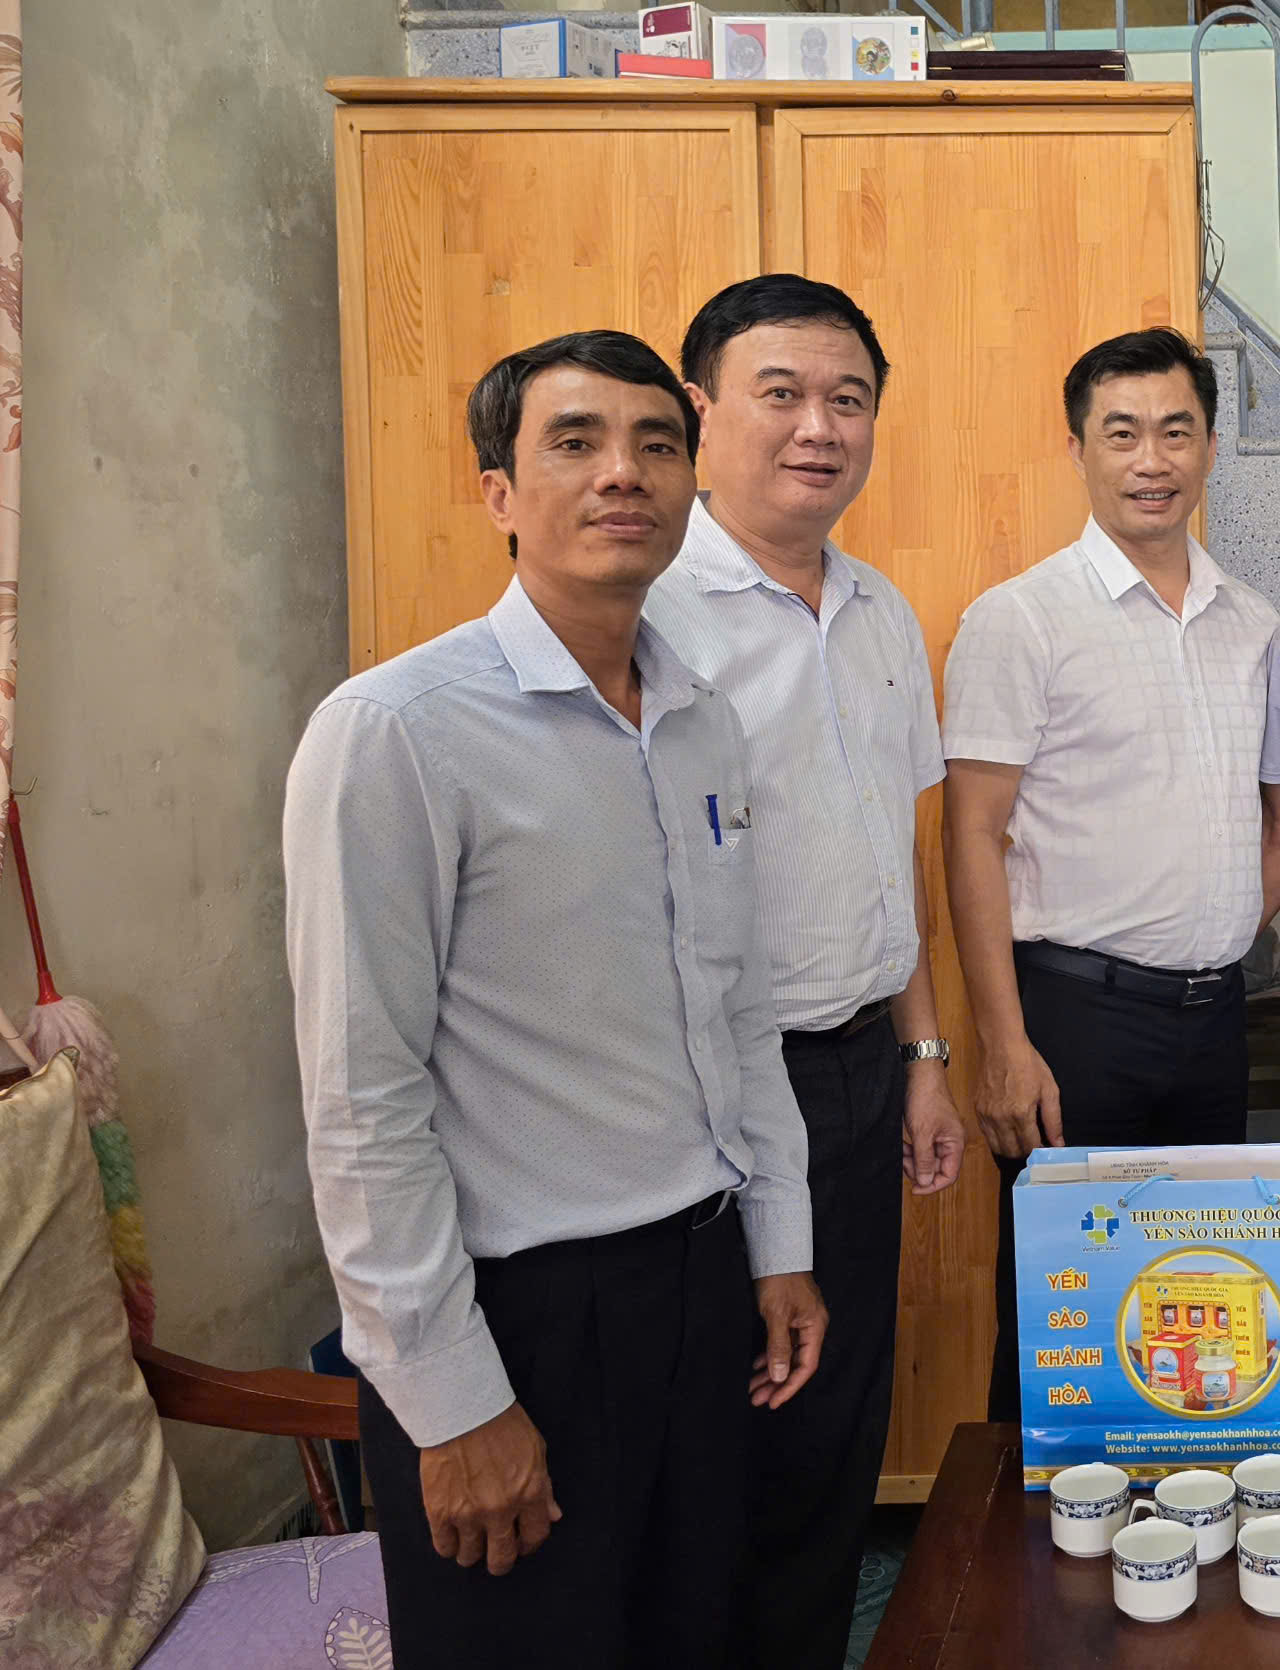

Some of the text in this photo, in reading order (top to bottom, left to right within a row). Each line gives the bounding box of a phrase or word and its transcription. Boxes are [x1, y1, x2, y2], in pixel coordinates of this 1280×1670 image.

[1129, 1208, 1196, 1223] THƯƠNG
[1200, 1207, 1238, 1225] HIỆU
[1143, 1225, 1175, 1241] YẾN
[1178, 1226, 1209, 1240] SÀO
[1212, 1225, 1267, 1240] KHÁNH
[1046, 1267, 1088, 1290] YẾN
[1048, 1306, 1088, 1329] SÀO
[1036, 1345, 1102, 1367] KHÁNH
[1048, 1382, 1092, 1405] HÒA
[1105, 1431, 1135, 1441] Email:
[1106, 1444, 1150, 1454] Website:
